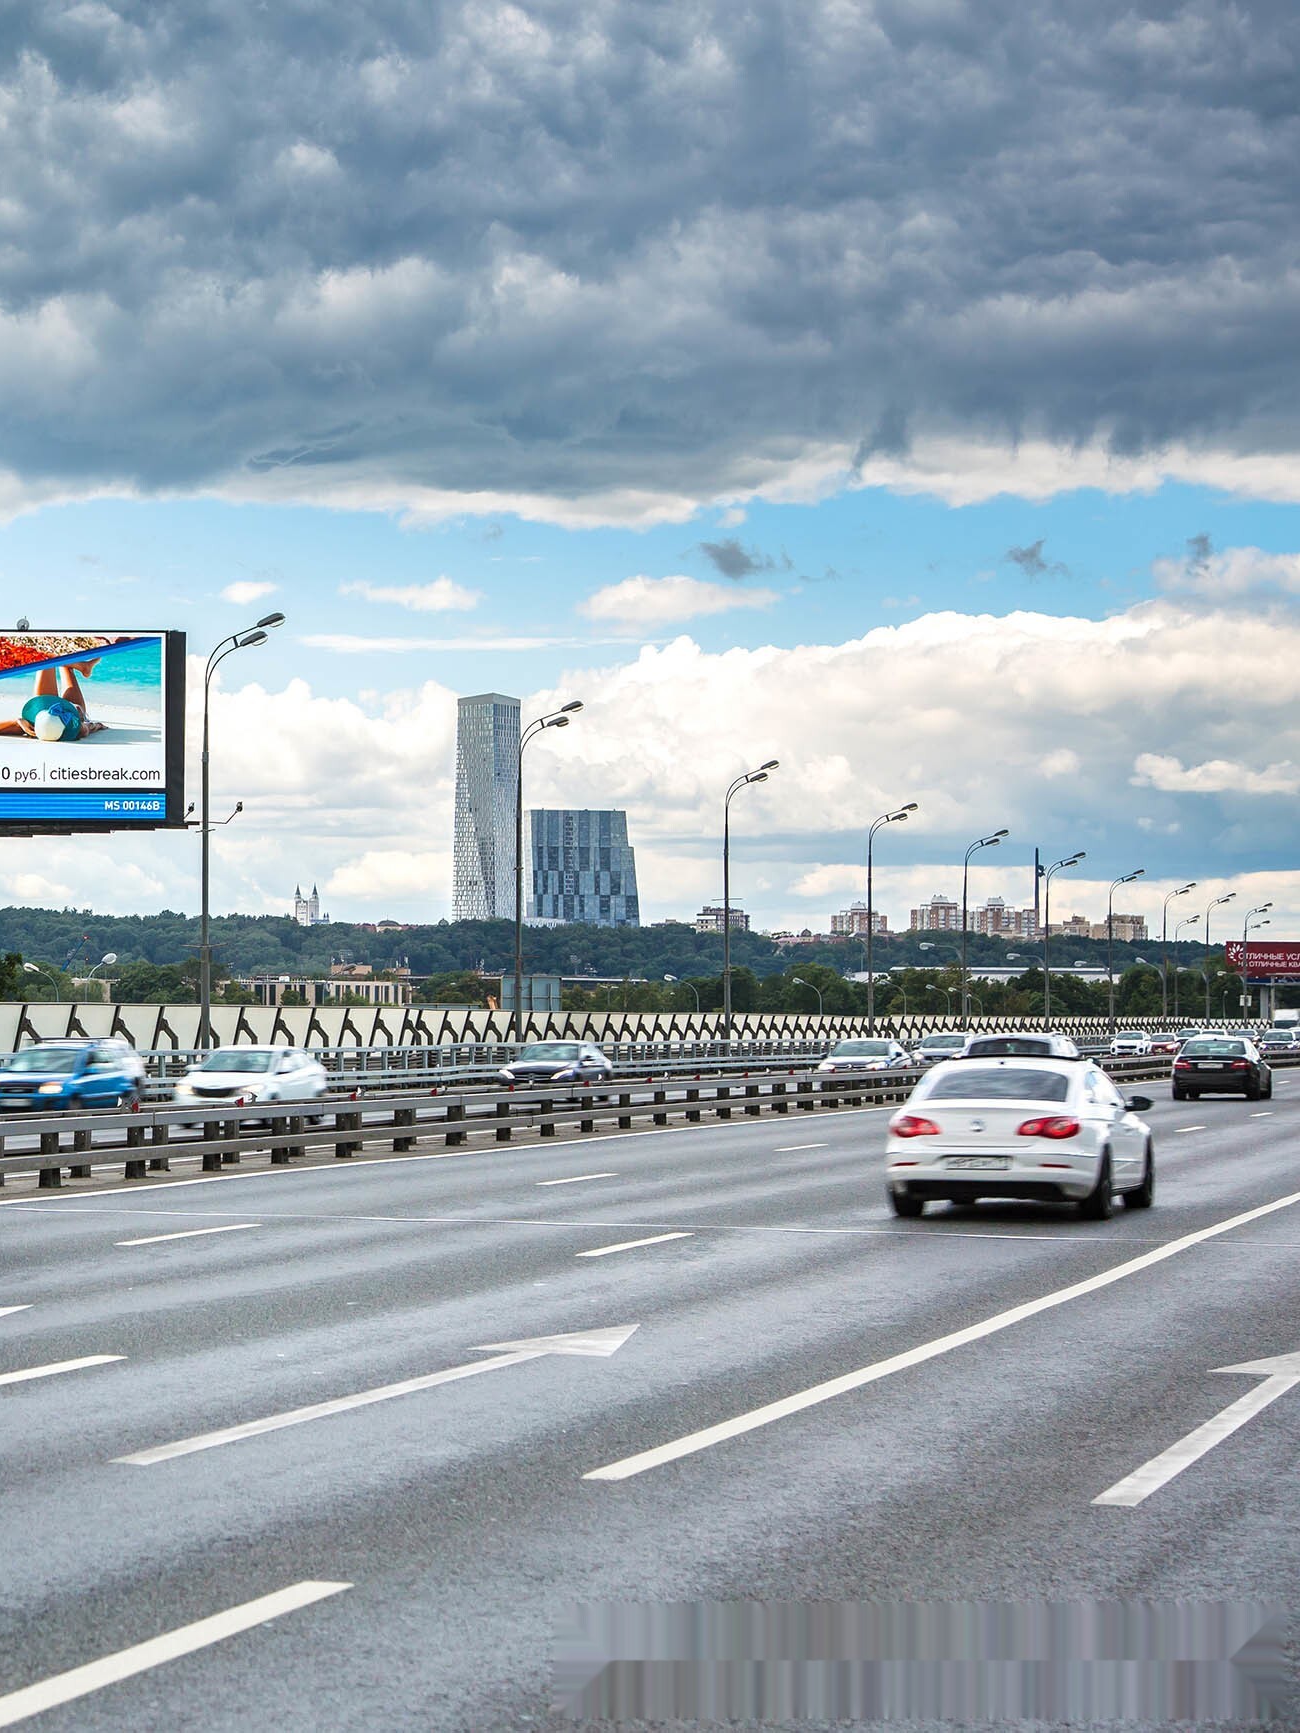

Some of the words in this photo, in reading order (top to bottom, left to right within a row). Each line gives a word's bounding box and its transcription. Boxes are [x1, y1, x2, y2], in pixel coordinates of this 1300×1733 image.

[14, 768, 41, 782] руб.
[49, 767, 161, 780] citiesbreak.com
[104, 801, 120, 811] MS
[123, 801, 160, 811] 00146B
